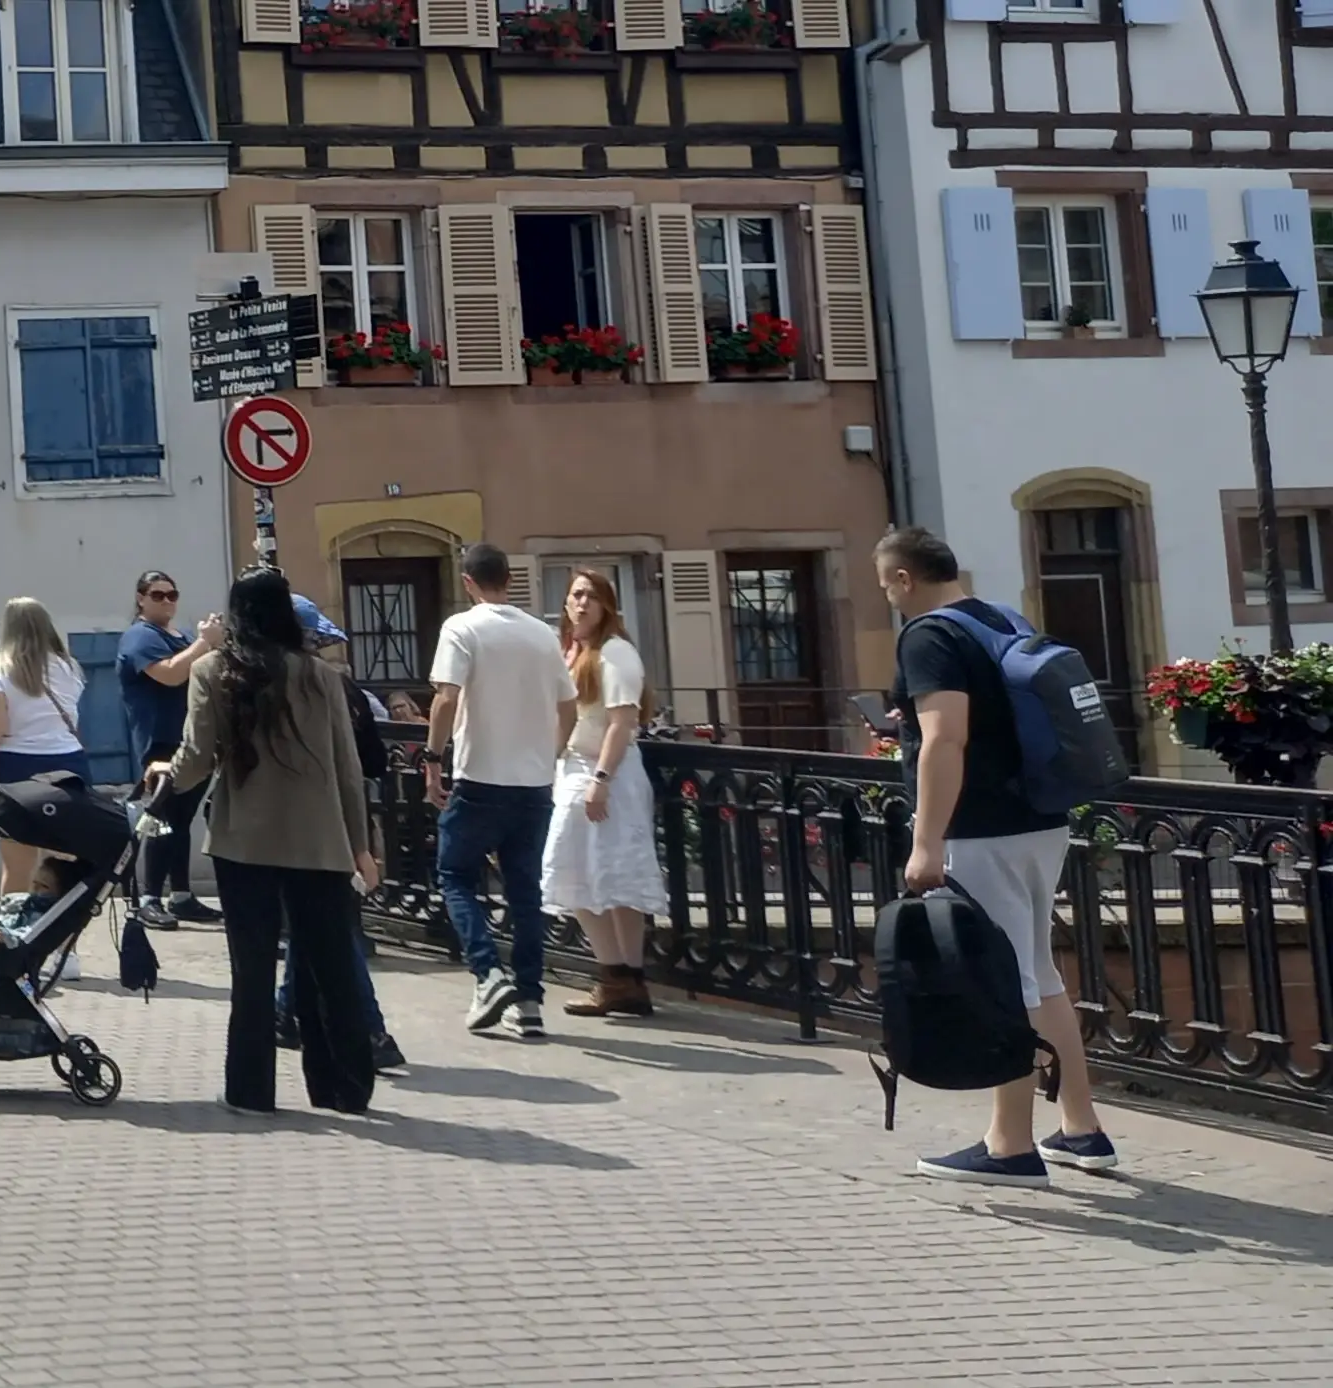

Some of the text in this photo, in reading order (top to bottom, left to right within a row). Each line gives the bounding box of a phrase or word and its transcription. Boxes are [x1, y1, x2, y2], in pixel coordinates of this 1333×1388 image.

[239, 305, 261, 318] Petite
[263, 300, 287, 313] Venise
[216, 330, 230, 342] Quai
[248, 320, 288, 337] Poissonnerie
[202, 349, 261, 366] Ancienne Douane
[220, 384, 228, 396] et
[387, 484, 400, 496] 19
